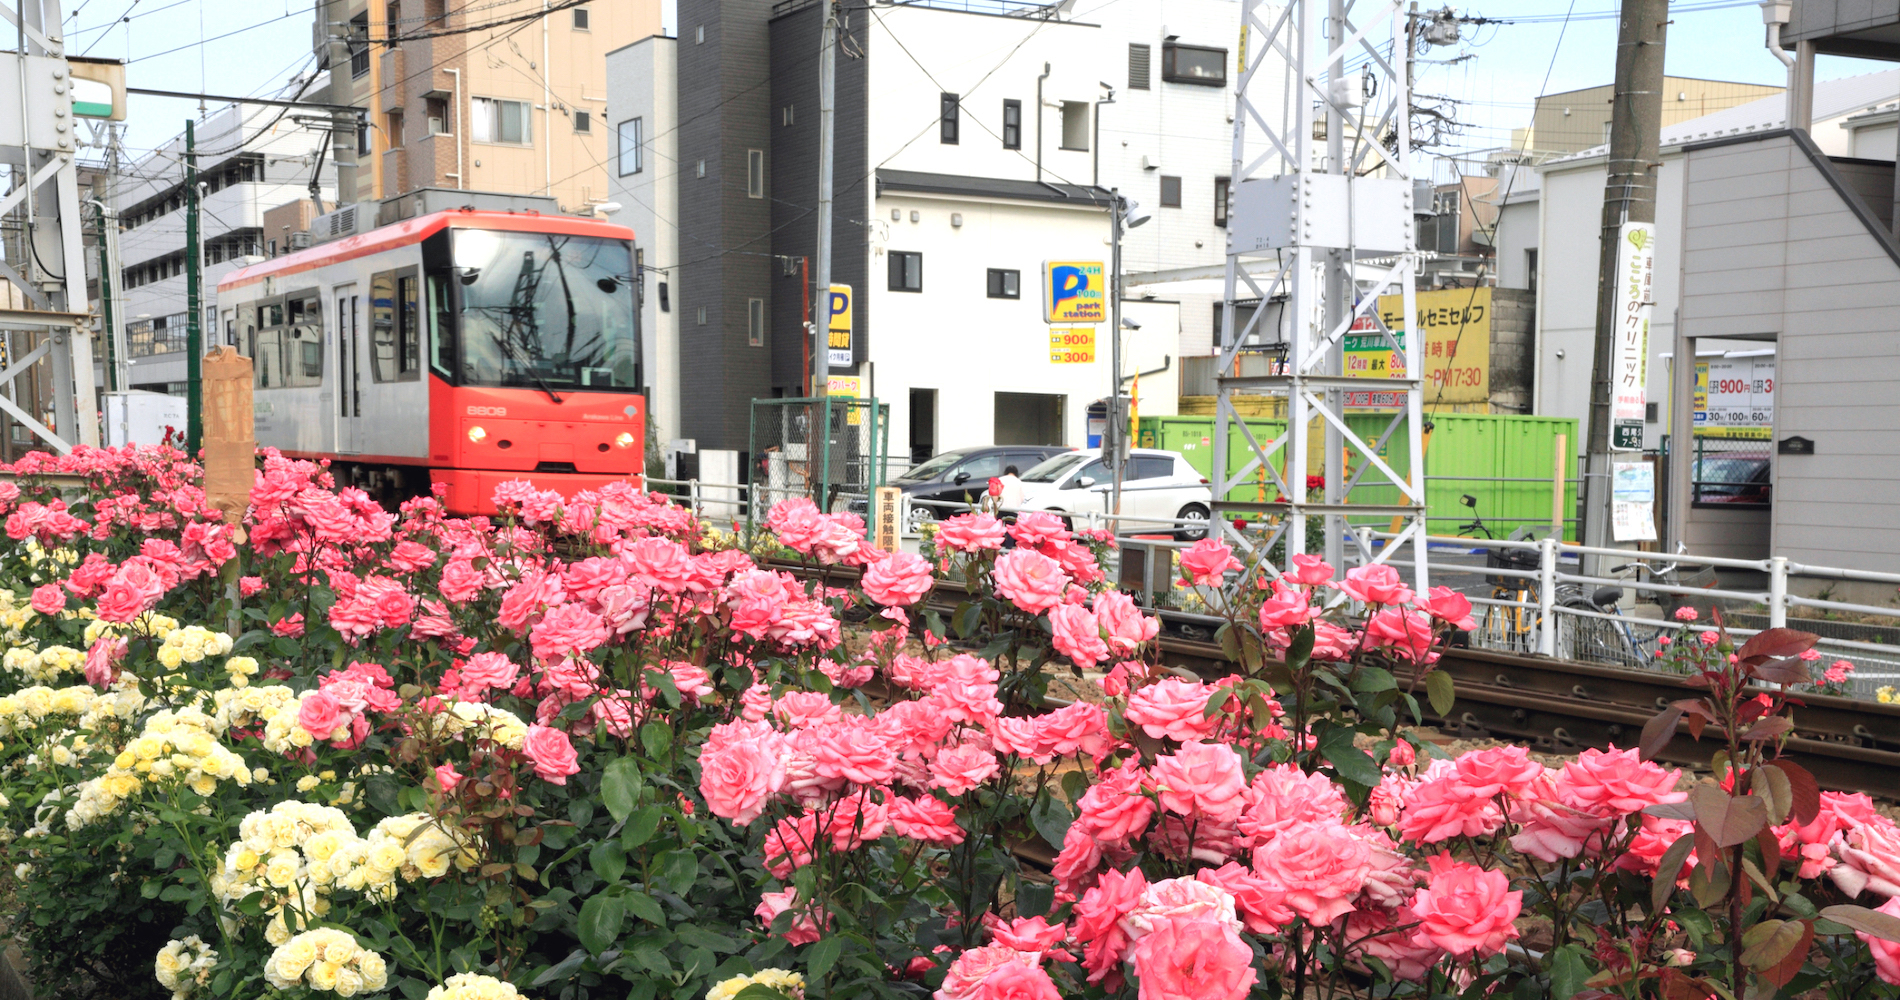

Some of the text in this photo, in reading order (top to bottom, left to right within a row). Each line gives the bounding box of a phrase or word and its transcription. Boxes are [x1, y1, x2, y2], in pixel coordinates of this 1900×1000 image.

[1079, 266, 1101, 275] 24H
[1052, 265, 1089, 315] P
[1076, 302, 1101, 311] park
[1063, 310, 1101, 318] station
[1383, 305, 1485, 329] モールセミセルフ
[1623, 255, 1642, 387] こころのクリニック
[1064, 334, 1094, 345] 900円
[1343, 337, 1358, 348] ーク
[1064, 352, 1094, 363] 300円
[1348, 355, 1368, 370] 12時間
[1371, 359, 1385, 370] 最大
[1720, 379, 1751, 393] 900円
[1764, 379, 1775, 393] 3
[467, 405, 507, 417] 8809
[1708, 412, 1748, 421] 30分/100円
[1622, 428, 1642, 437] 西尾久
